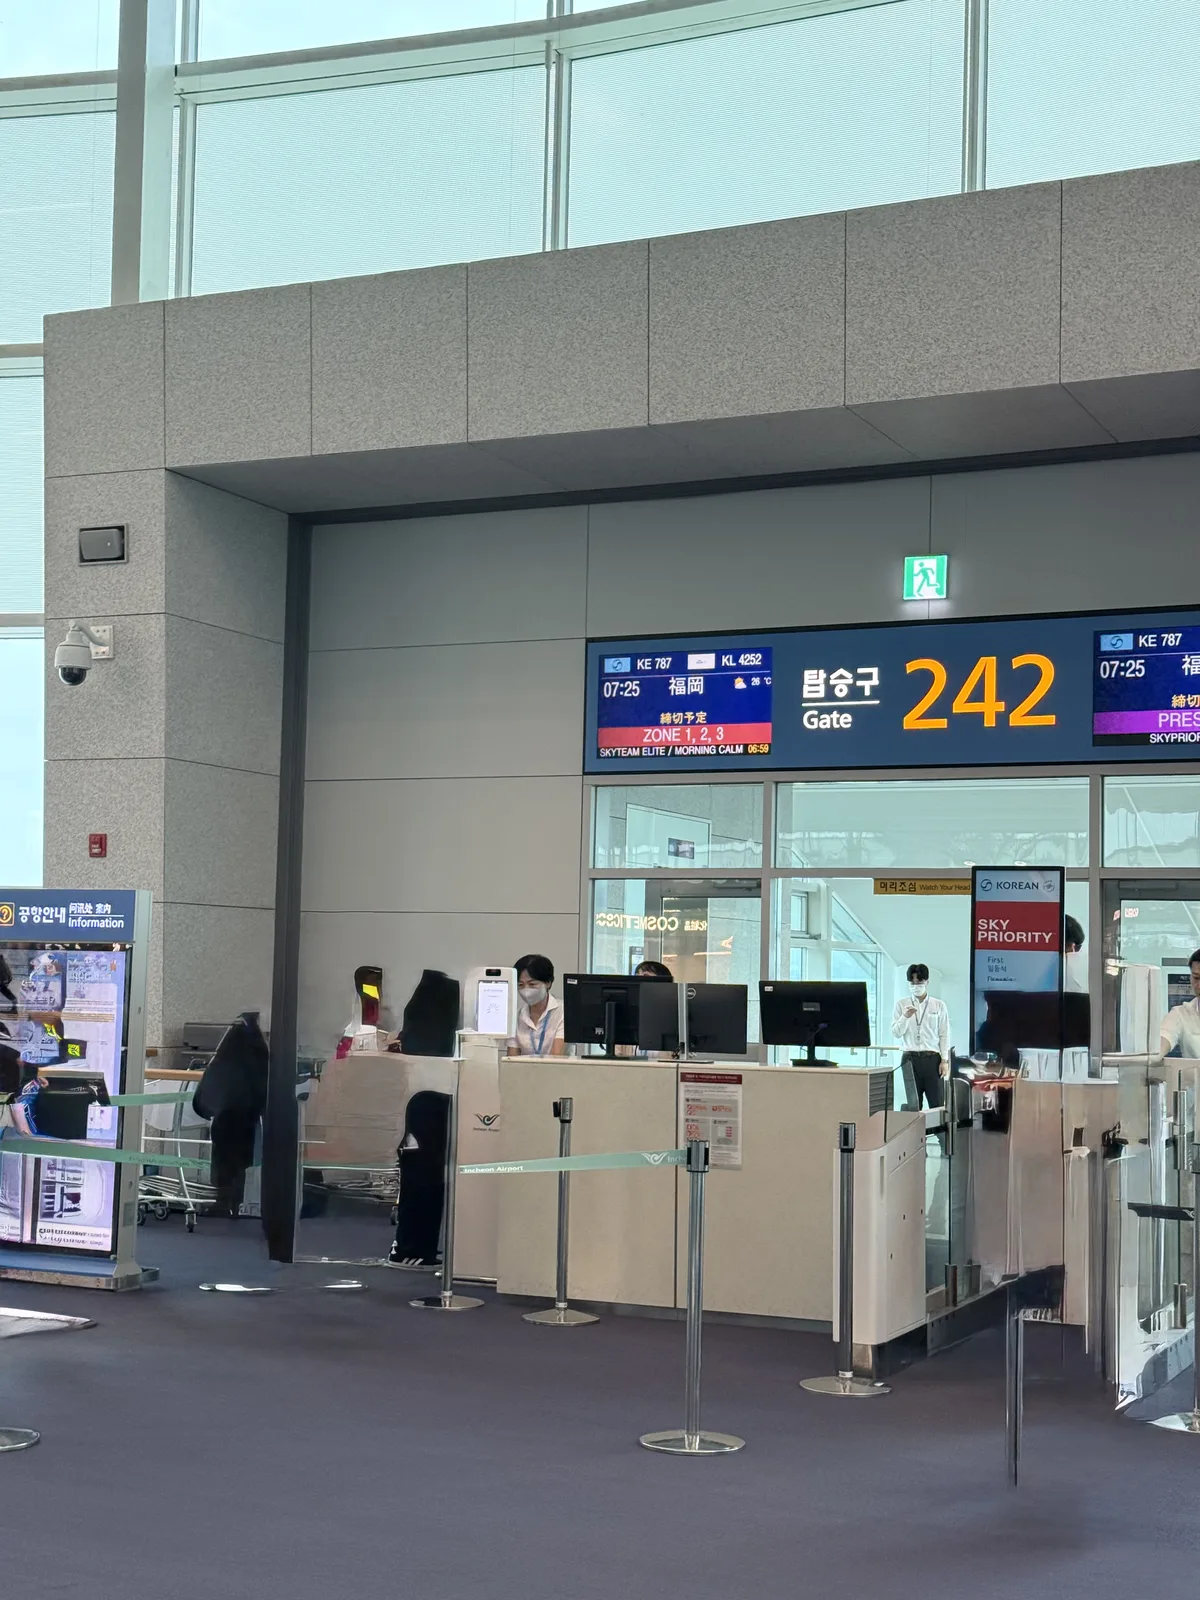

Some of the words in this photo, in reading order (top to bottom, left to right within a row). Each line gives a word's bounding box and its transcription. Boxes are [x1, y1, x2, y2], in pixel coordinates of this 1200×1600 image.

[1138, 634, 1158, 648] KE
[1160, 632, 1183, 647] 787
[636, 658, 653, 670] KE
[654, 657, 672, 670] 787
[721, 654, 737, 666] KL
[738, 653, 762, 665] 4252
[1100, 659, 1146, 679] 07:25
[668, 676, 704, 695] 福岡
[751, 677, 760, 686] 26
[802, 667, 880, 698] 탑승구
[603, 680, 641, 698] 07:25
[903, 653, 1056, 730] 242
[660, 711, 707, 725] 締切予定
[802, 709, 853, 729] Gate
[643, 728, 681, 742] ZONE
[686, 728, 696, 744] 1,
[700, 727, 712, 743] 2,
[716, 726, 724, 741] 3
[600, 747, 640, 757] SKYTEAM
[642, 747, 665, 756] ELITE
[674, 745, 716, 755] MORNING
[720, 744, 743, 754] CALM
[748, 743, 769, 754] 06:59
[880, 881, 917, 893] 머리조심
[996, 881, 1039, 890] KOREAN
[18, 906, 67, 924] 공항안내
[68, 917, 125, 928] Information
[977, 919, 1010, 930] SKY
[977, 932, 1052, 943] PRIORITY
[987, 956, 1004, 964] First
[987, 964, 1007, 973] 일등석
